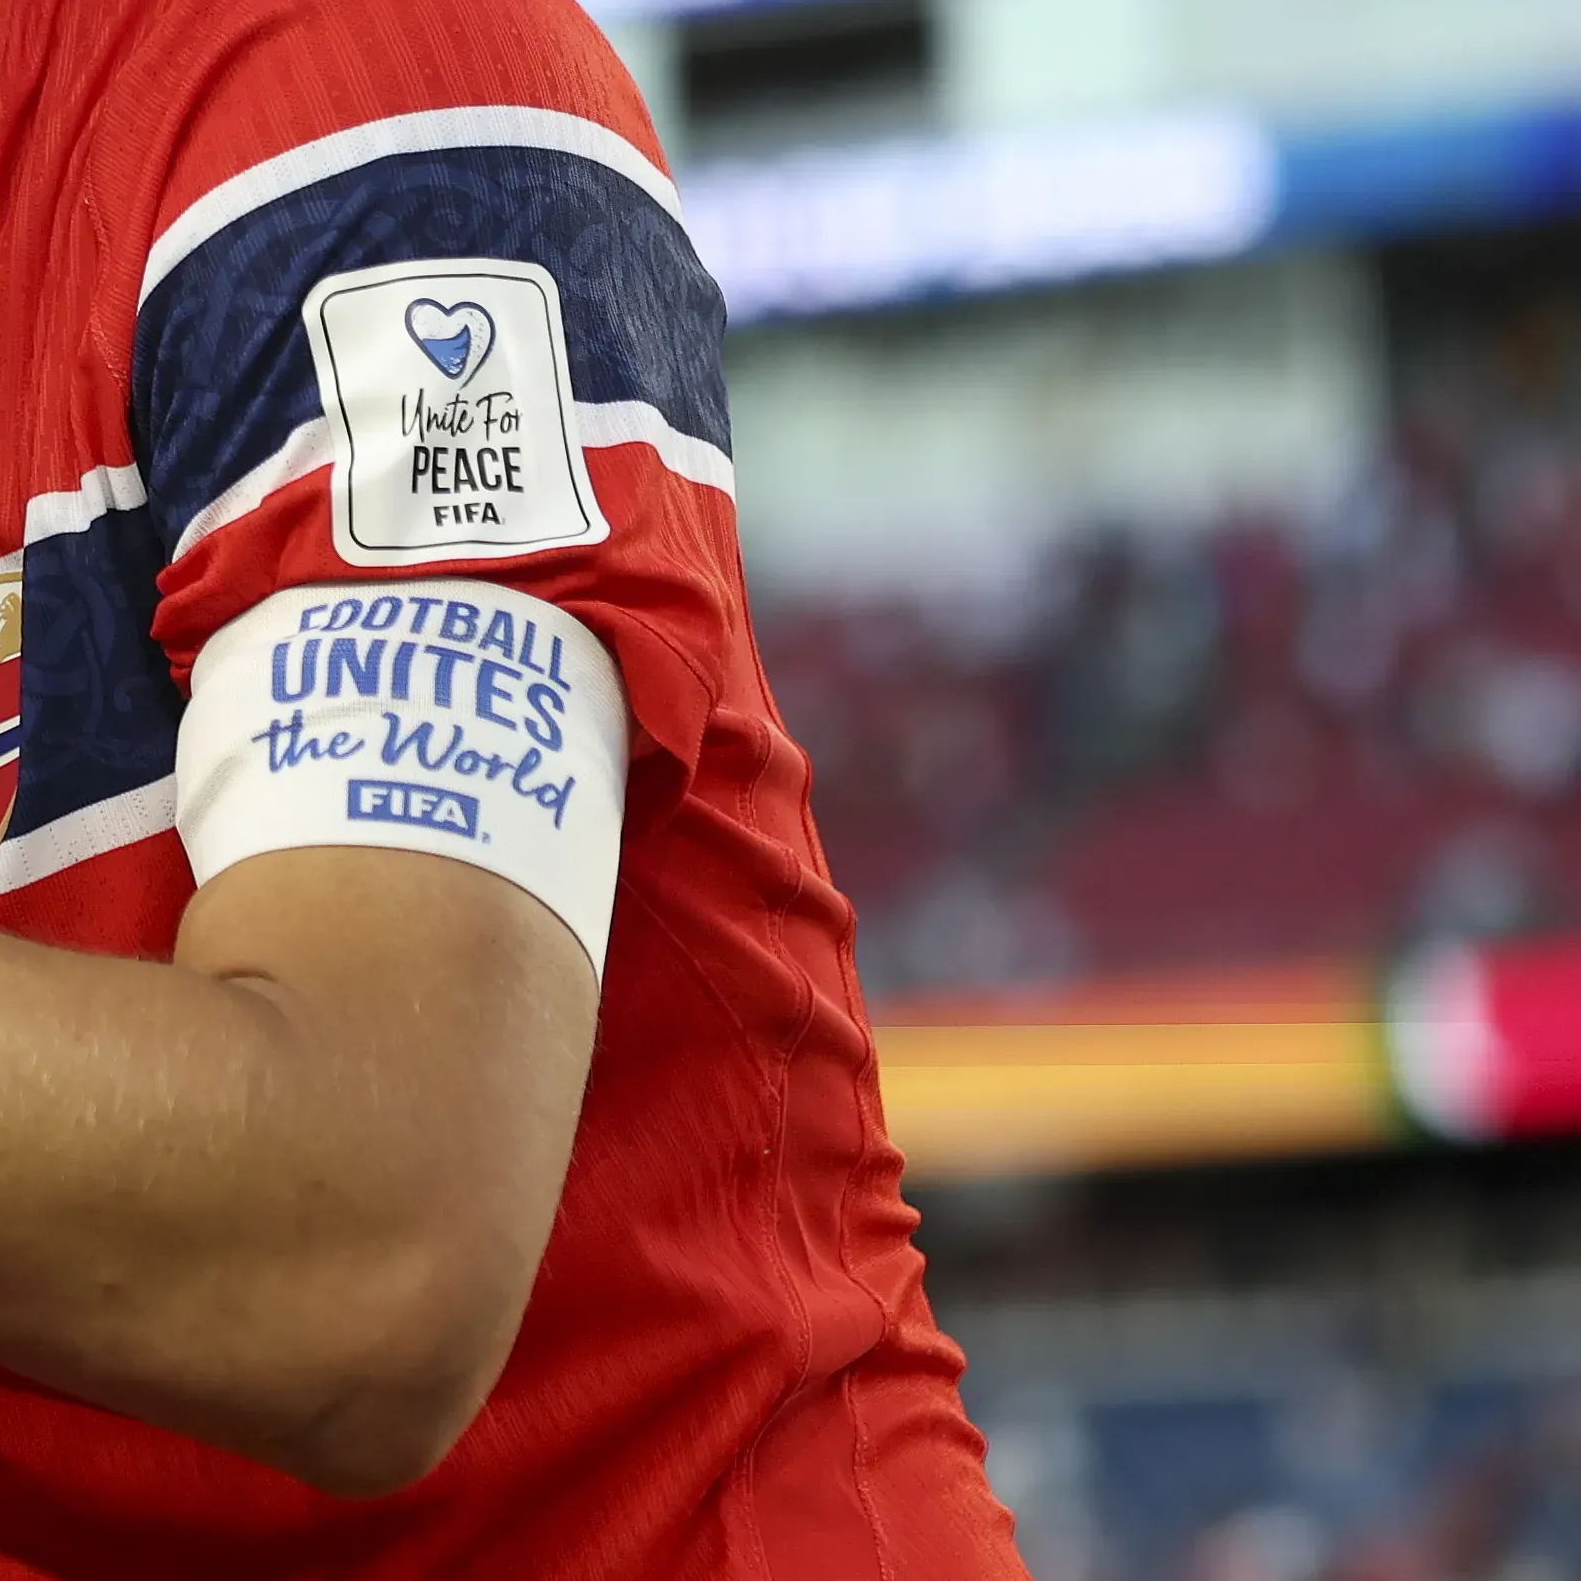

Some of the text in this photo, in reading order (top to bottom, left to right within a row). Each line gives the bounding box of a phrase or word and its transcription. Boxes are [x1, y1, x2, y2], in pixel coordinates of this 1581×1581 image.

[401, 387, 521, 444] Unite For
[411, 445, 525, 495] PEACE
[432, 501, 502, 528] FIFA
[297, 595, 573, 692] FOOTBALL
[271, 637, 567, 752] UNITES
[251, 708, 578, 831] the World
[359, 784, 470, 831] FIFA
